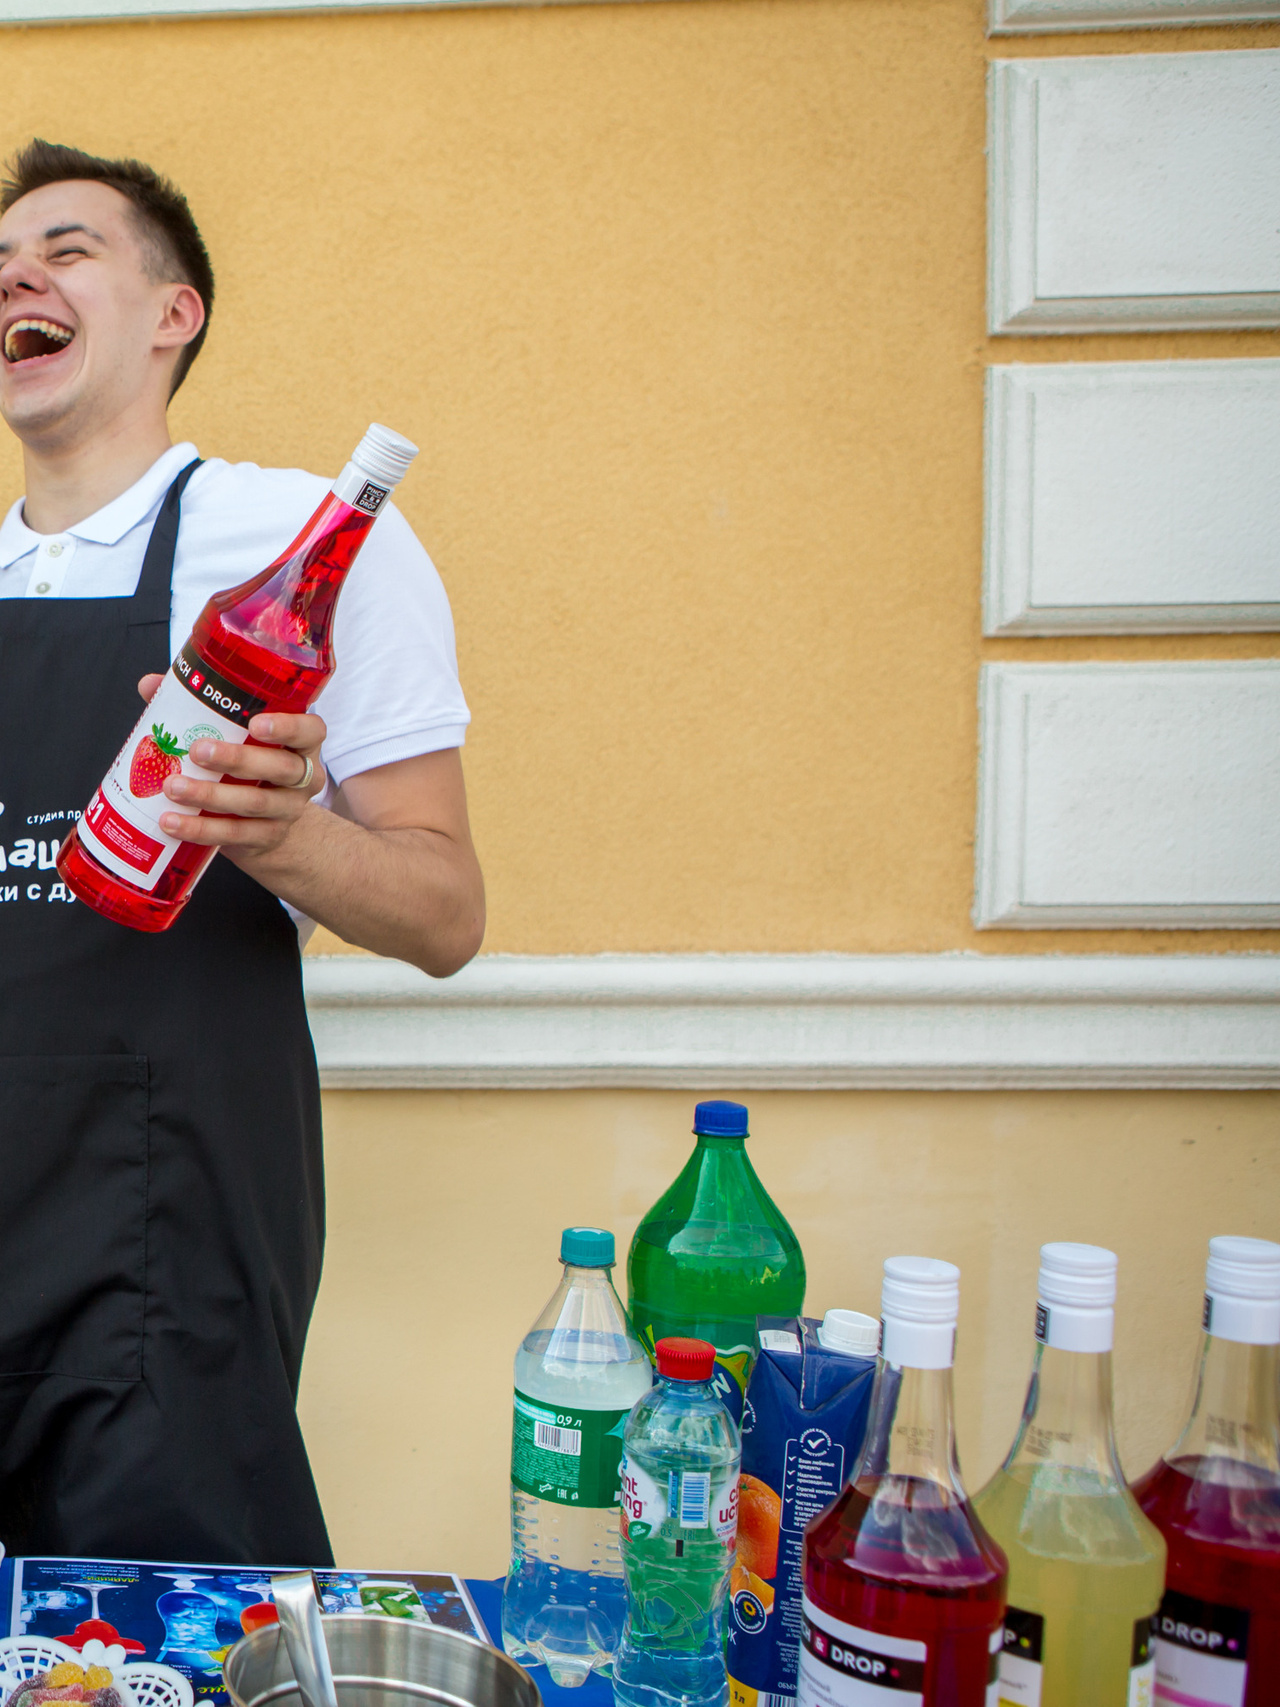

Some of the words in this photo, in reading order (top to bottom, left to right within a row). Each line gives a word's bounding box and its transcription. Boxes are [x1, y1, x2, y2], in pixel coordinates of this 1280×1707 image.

[191, 674, 200, 687] &
[202, 683, 242, 713] DROP
[26, 810, 65, 826] студия
[67, 809, 84, 822] пр
[26, 883, 42, 900] с
[557, 1414, 573, 1426] 0,9
[574, 1419, 582, 1427] л
[1161, 1616, 1224, 1649] DROP
[831, 1644, 886, 1677] DROP
